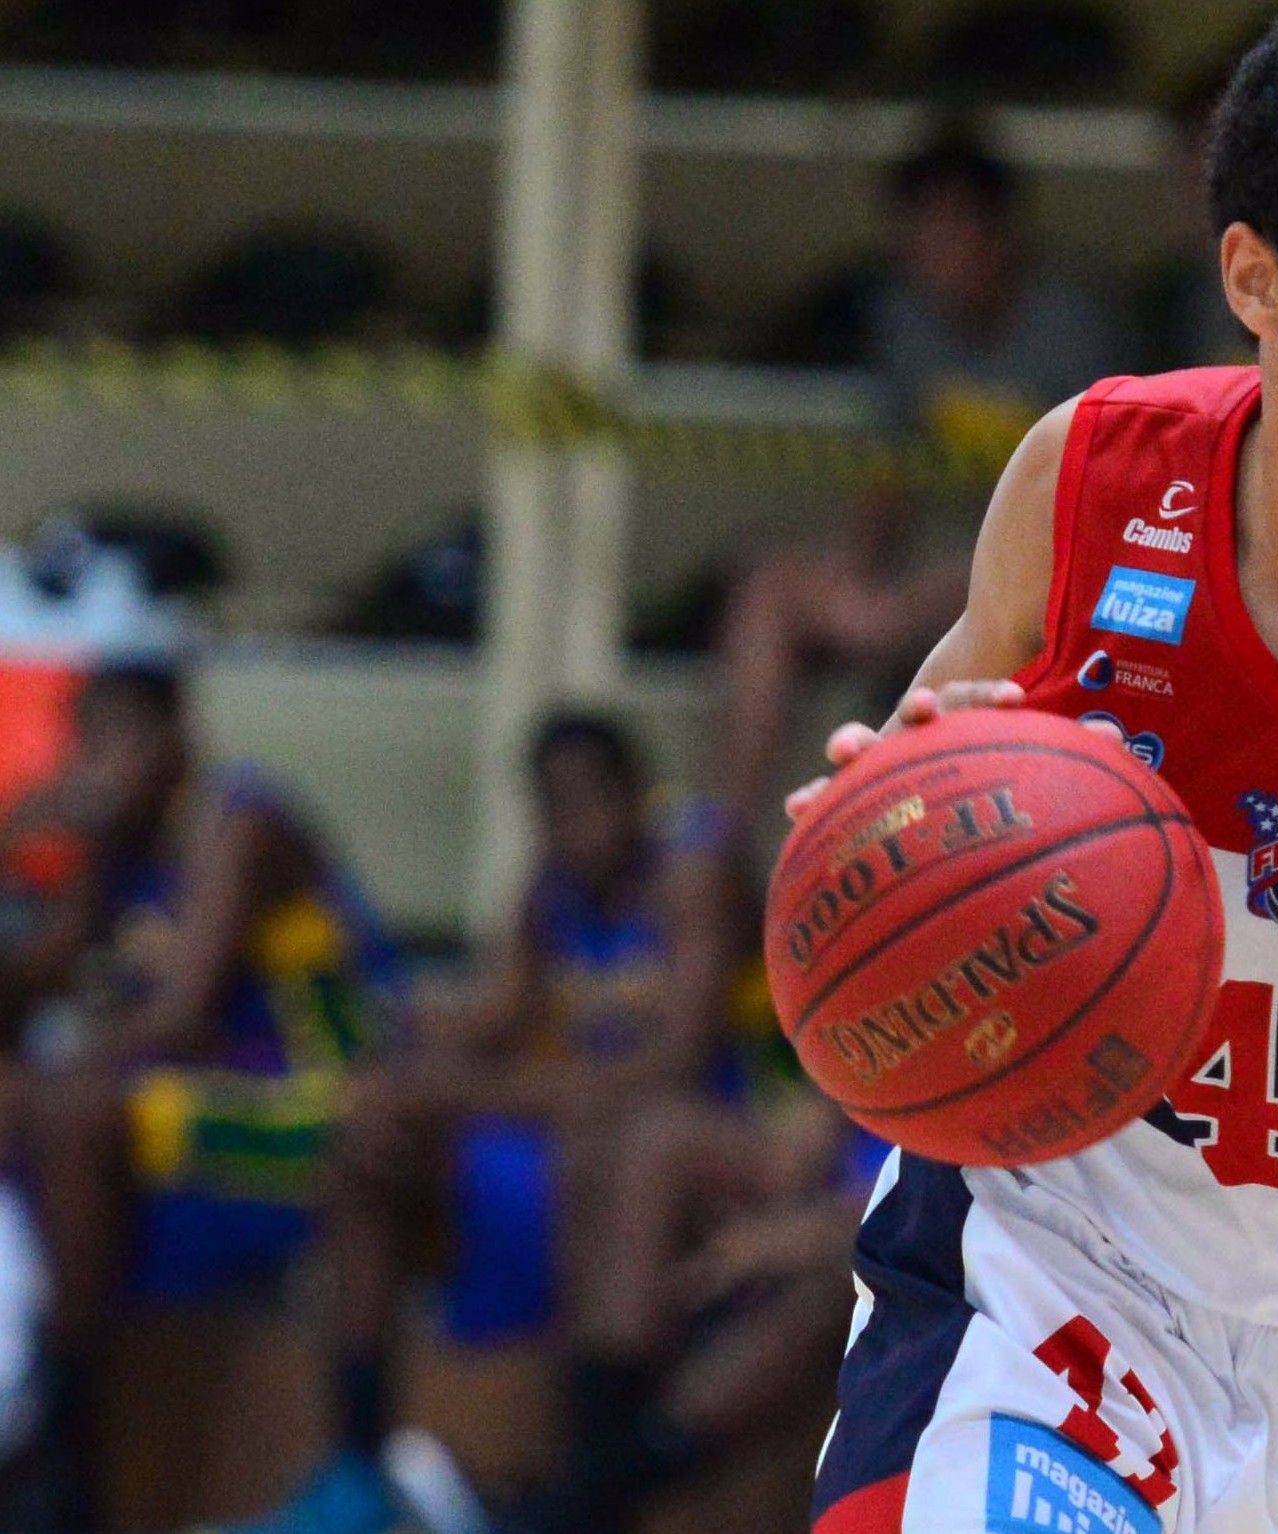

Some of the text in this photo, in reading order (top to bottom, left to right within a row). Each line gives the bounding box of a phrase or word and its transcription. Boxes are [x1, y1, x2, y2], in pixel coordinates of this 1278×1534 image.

[1123, 517, 1193, 553] Cambs
[1113, 578, 1183, 602] magazine
[1101, 592, 1175, 633] luiza
[1115, 669, 1174, 696] FRANCA
[826, 866, 1100, 1083] SPALDING
